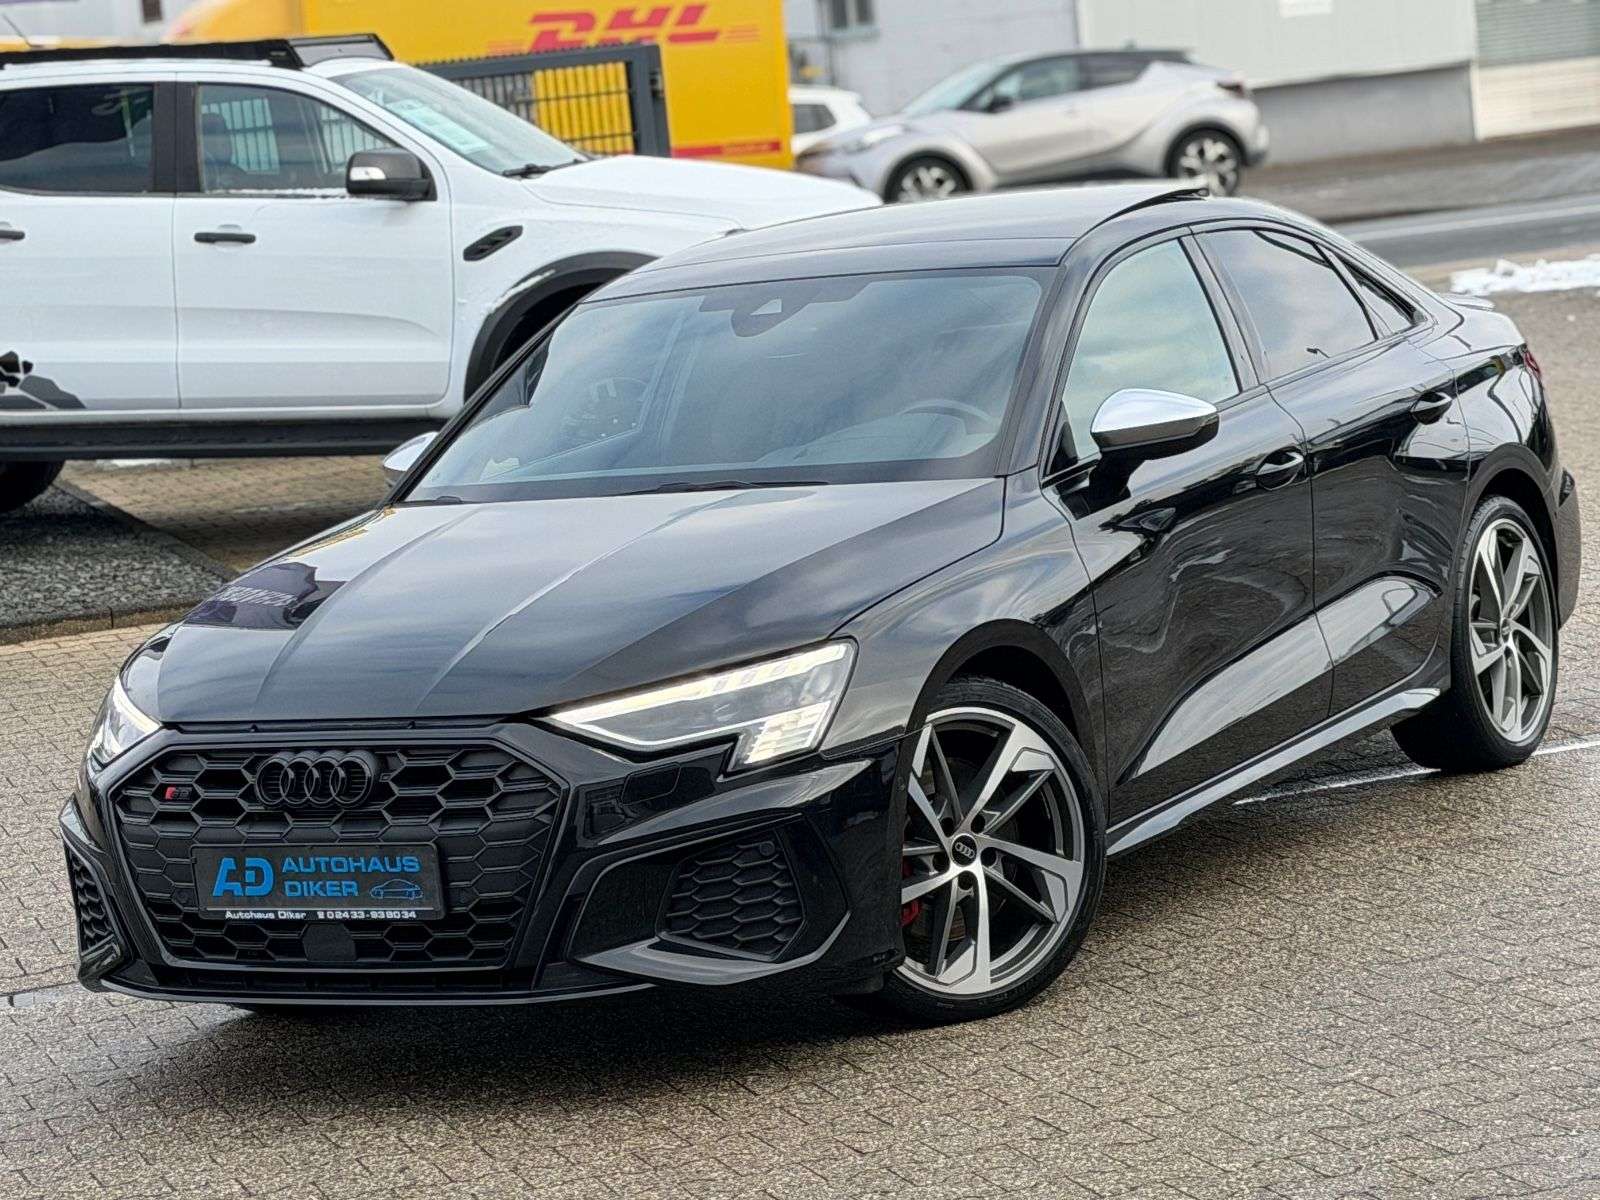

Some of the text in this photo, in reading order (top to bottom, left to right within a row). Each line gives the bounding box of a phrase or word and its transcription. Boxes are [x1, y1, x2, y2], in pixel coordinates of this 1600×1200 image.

[529, 4, 720, 54] DHL
[282, 855, 421, 873] AUTOHAUS
[284, 880, 359, 897] DIKER
[225, 910, 275, 920] Autohaus
[278, 910, 306, 920] Diker
